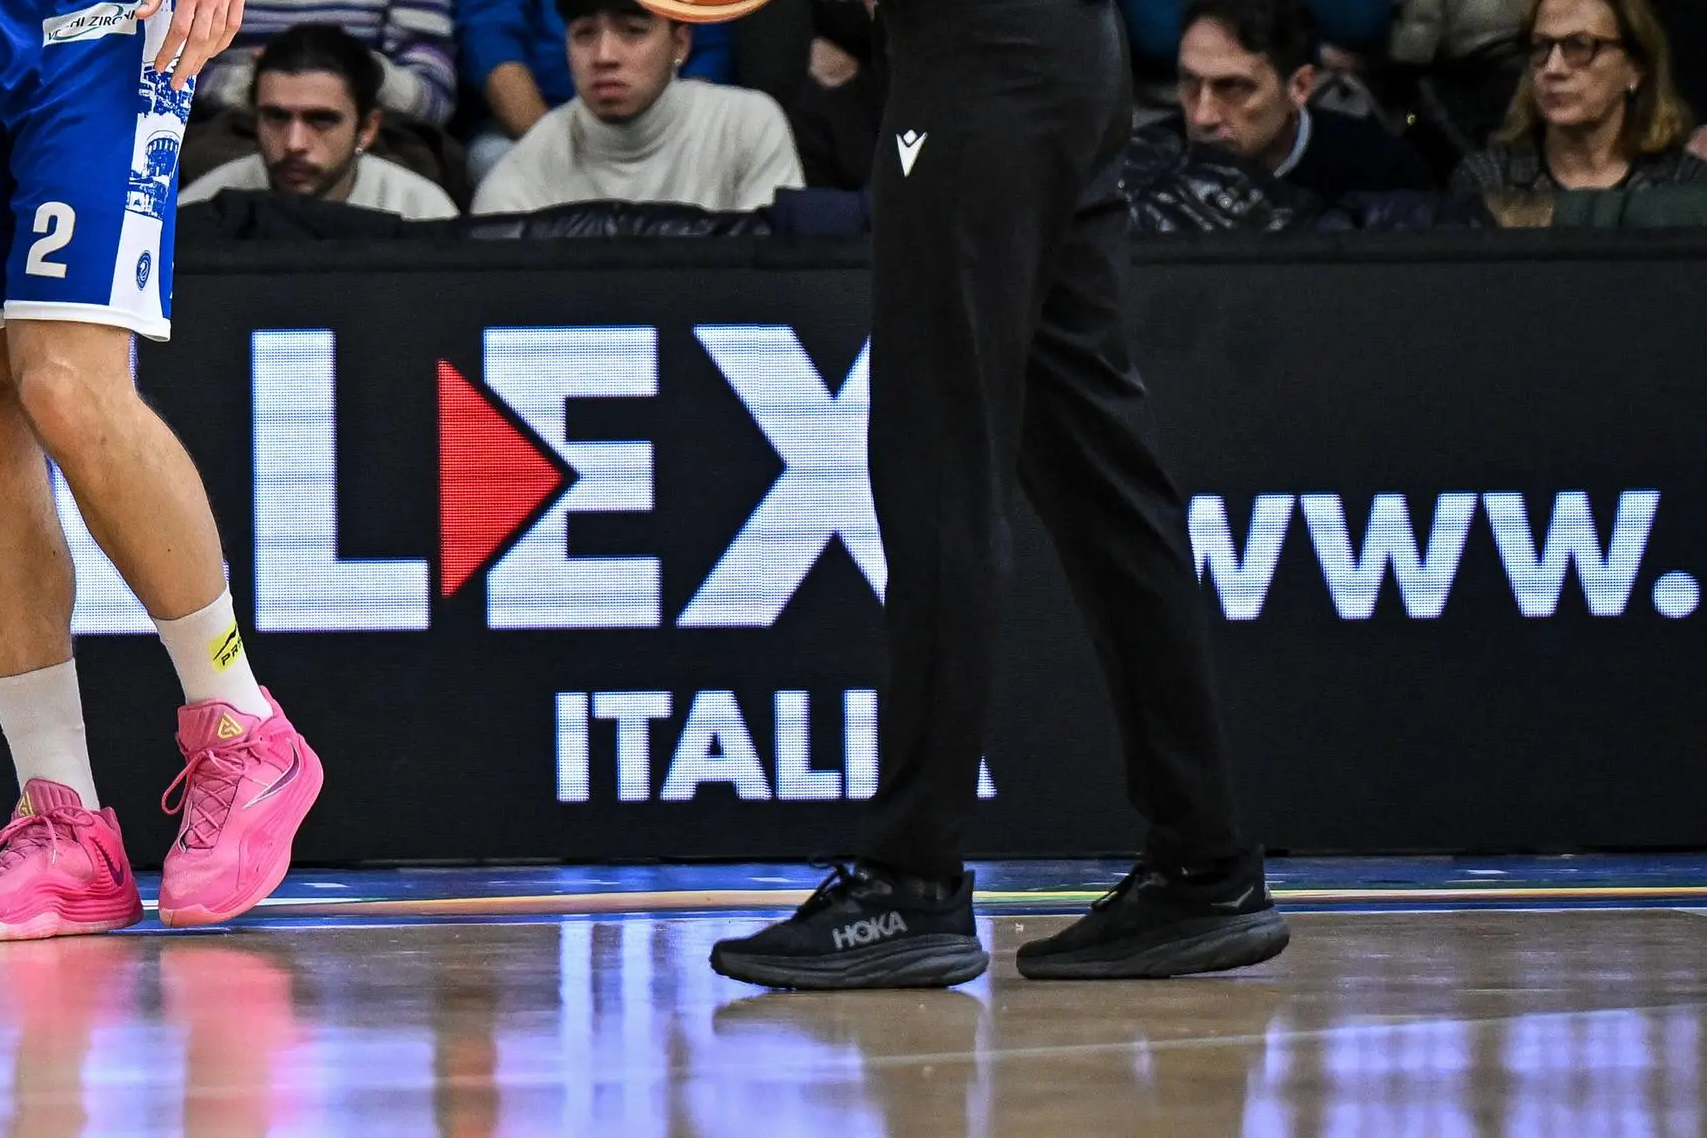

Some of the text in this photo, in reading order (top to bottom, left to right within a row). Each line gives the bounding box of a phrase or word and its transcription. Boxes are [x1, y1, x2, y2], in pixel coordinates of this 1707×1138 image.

[25, 201, 76, 279] 2
[555, 690, 998, 802] ITALI
[832, 910, 909, 951] HOKA
